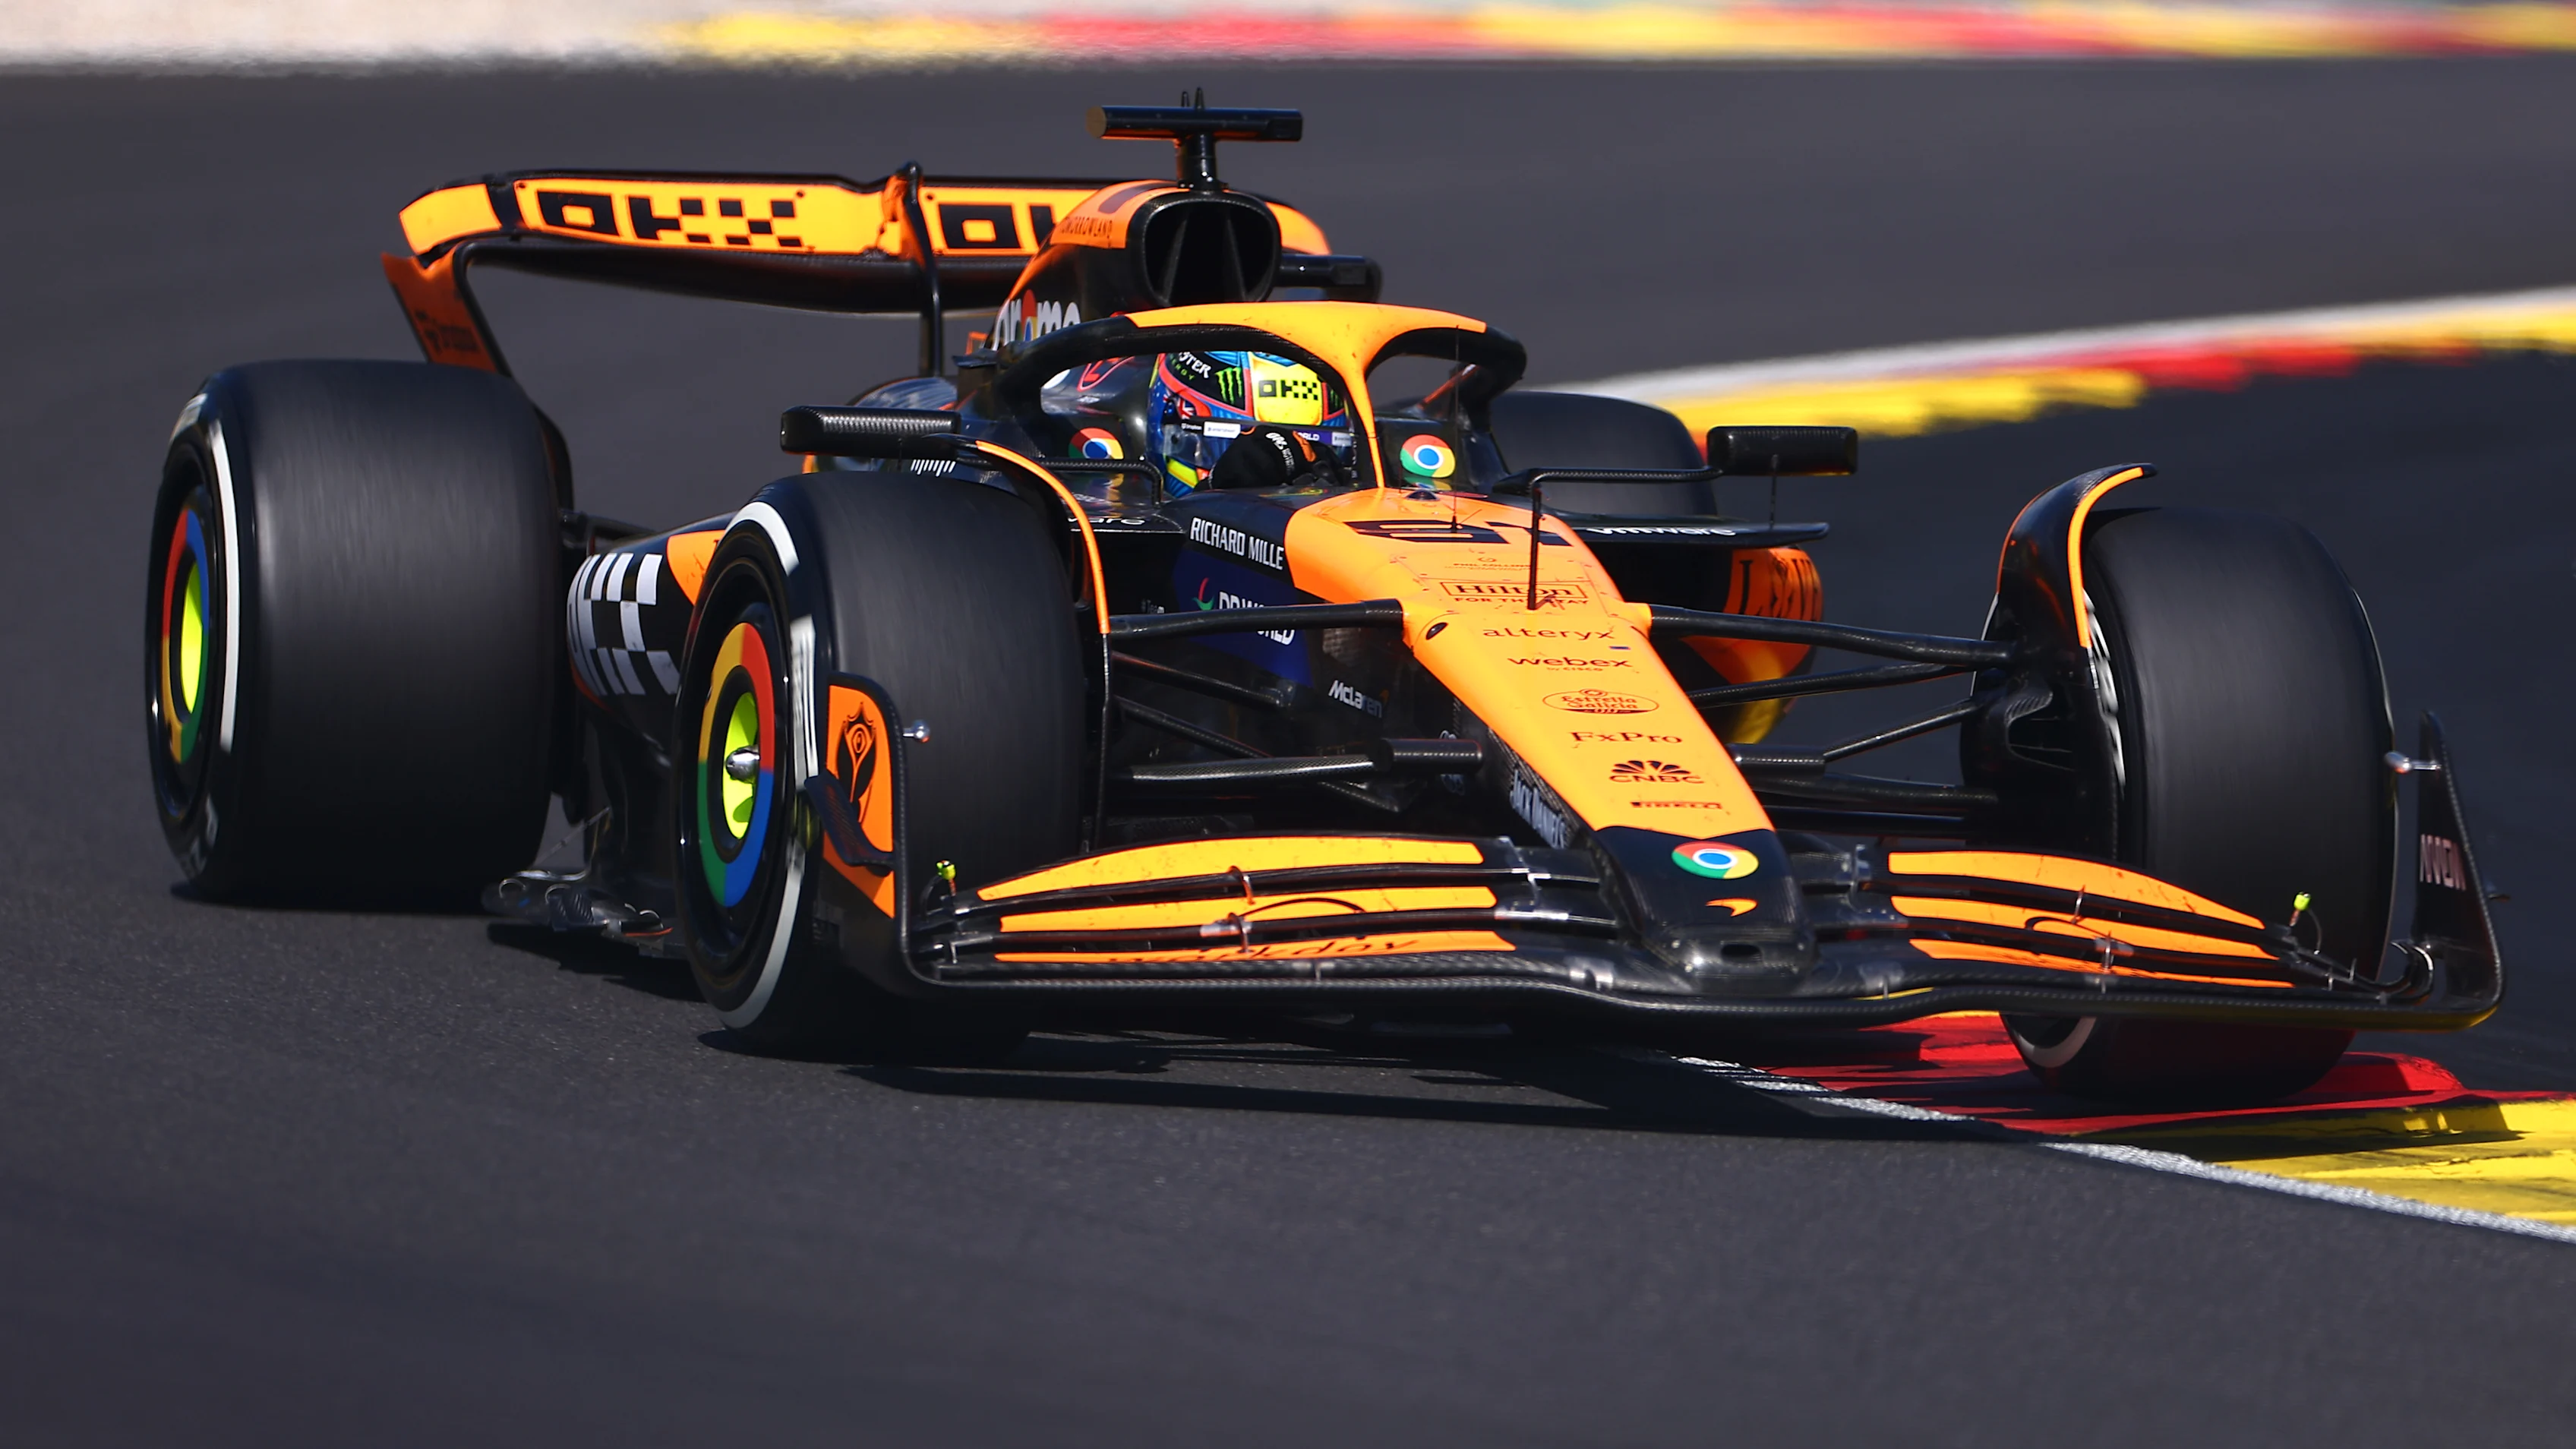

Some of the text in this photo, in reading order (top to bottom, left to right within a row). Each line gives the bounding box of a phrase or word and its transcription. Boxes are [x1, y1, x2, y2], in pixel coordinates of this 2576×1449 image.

[536, 190, 803, 247] OKX
[1258, 380, 1319, 401] OKX
[1343, 519, 1574, 547] 81
[1189, 517, 1285, 570] RICHARD MILLE
[1454, 585, 1574, 595] Hilton
[1482, 627, 1615, 641] alteryx
[1507, 656, 1634, 668] webex
[1327, 679, 1382, 718] McLaren
[1561, 695, 1638, 704] Estrella
[1567, 731, 1684, 744] FxPro
[1608, 775, 1705, 784] CNBC
